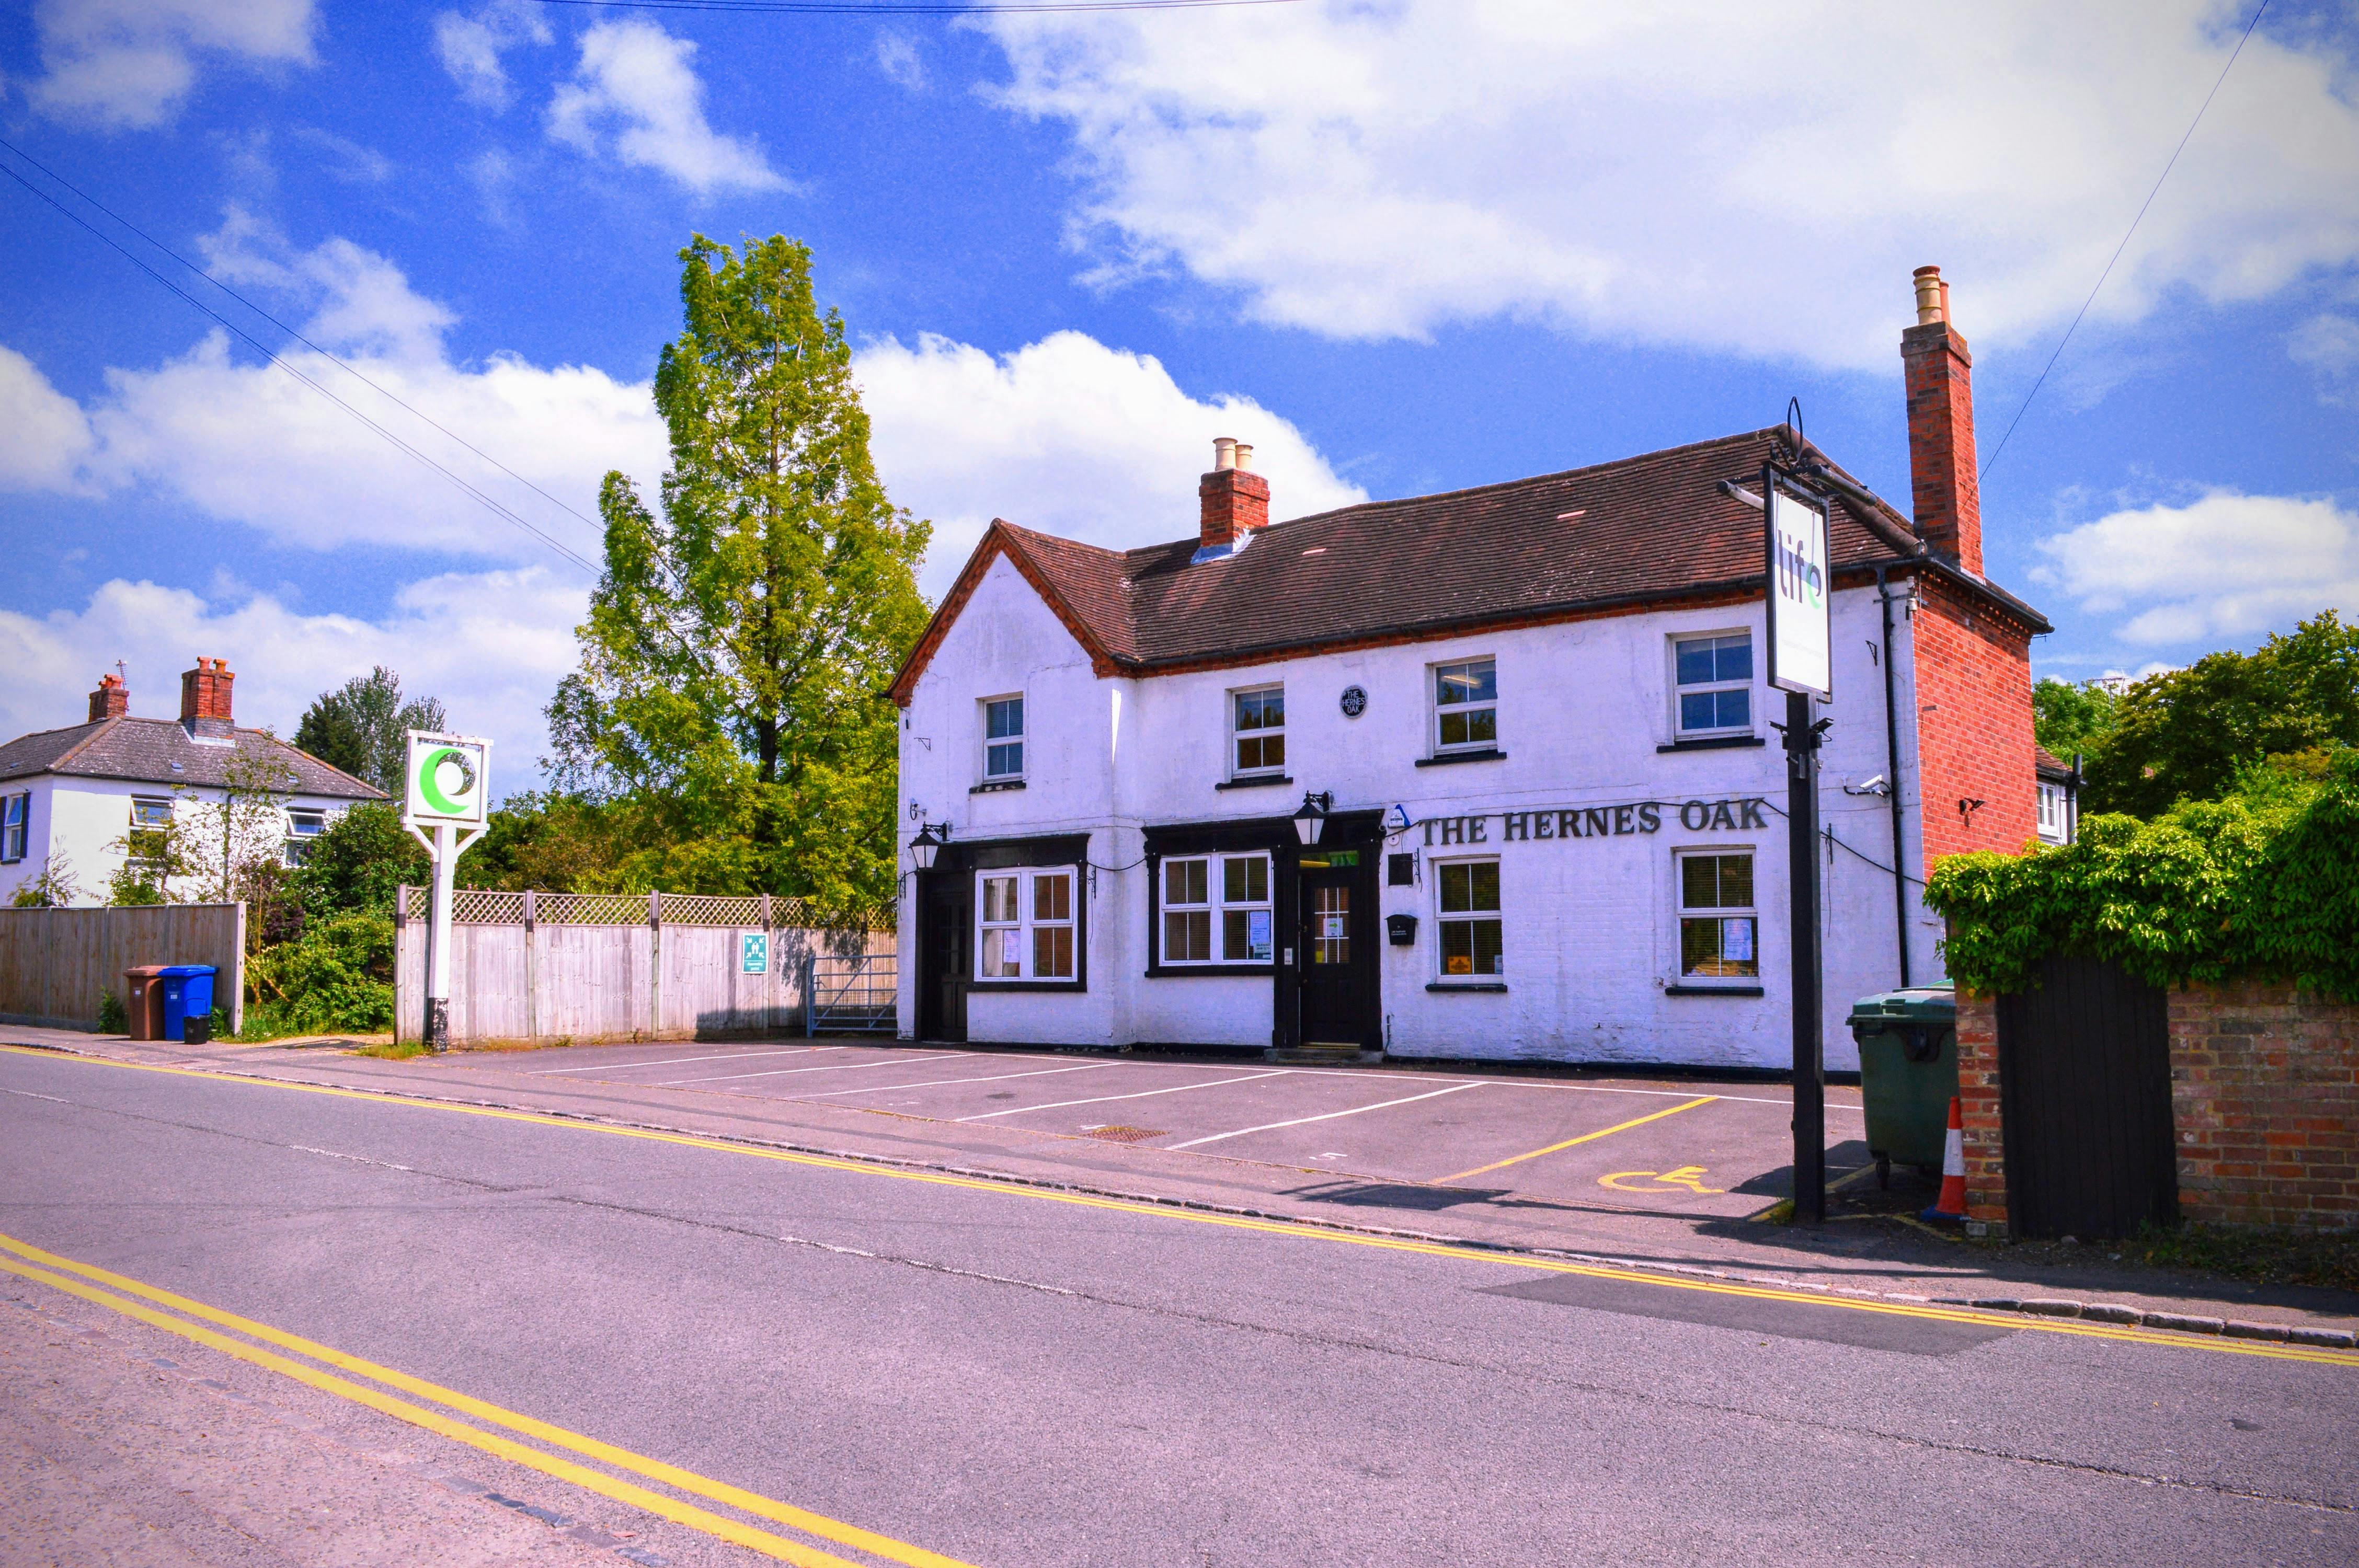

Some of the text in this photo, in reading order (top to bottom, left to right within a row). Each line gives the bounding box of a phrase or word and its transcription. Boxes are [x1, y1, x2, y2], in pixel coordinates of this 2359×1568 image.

[1346, 690, 1359, 699] THE
[1342, 698, 1366, 707] HERNES
[1418, 797, 1769, 846] THE HERNES OAK
